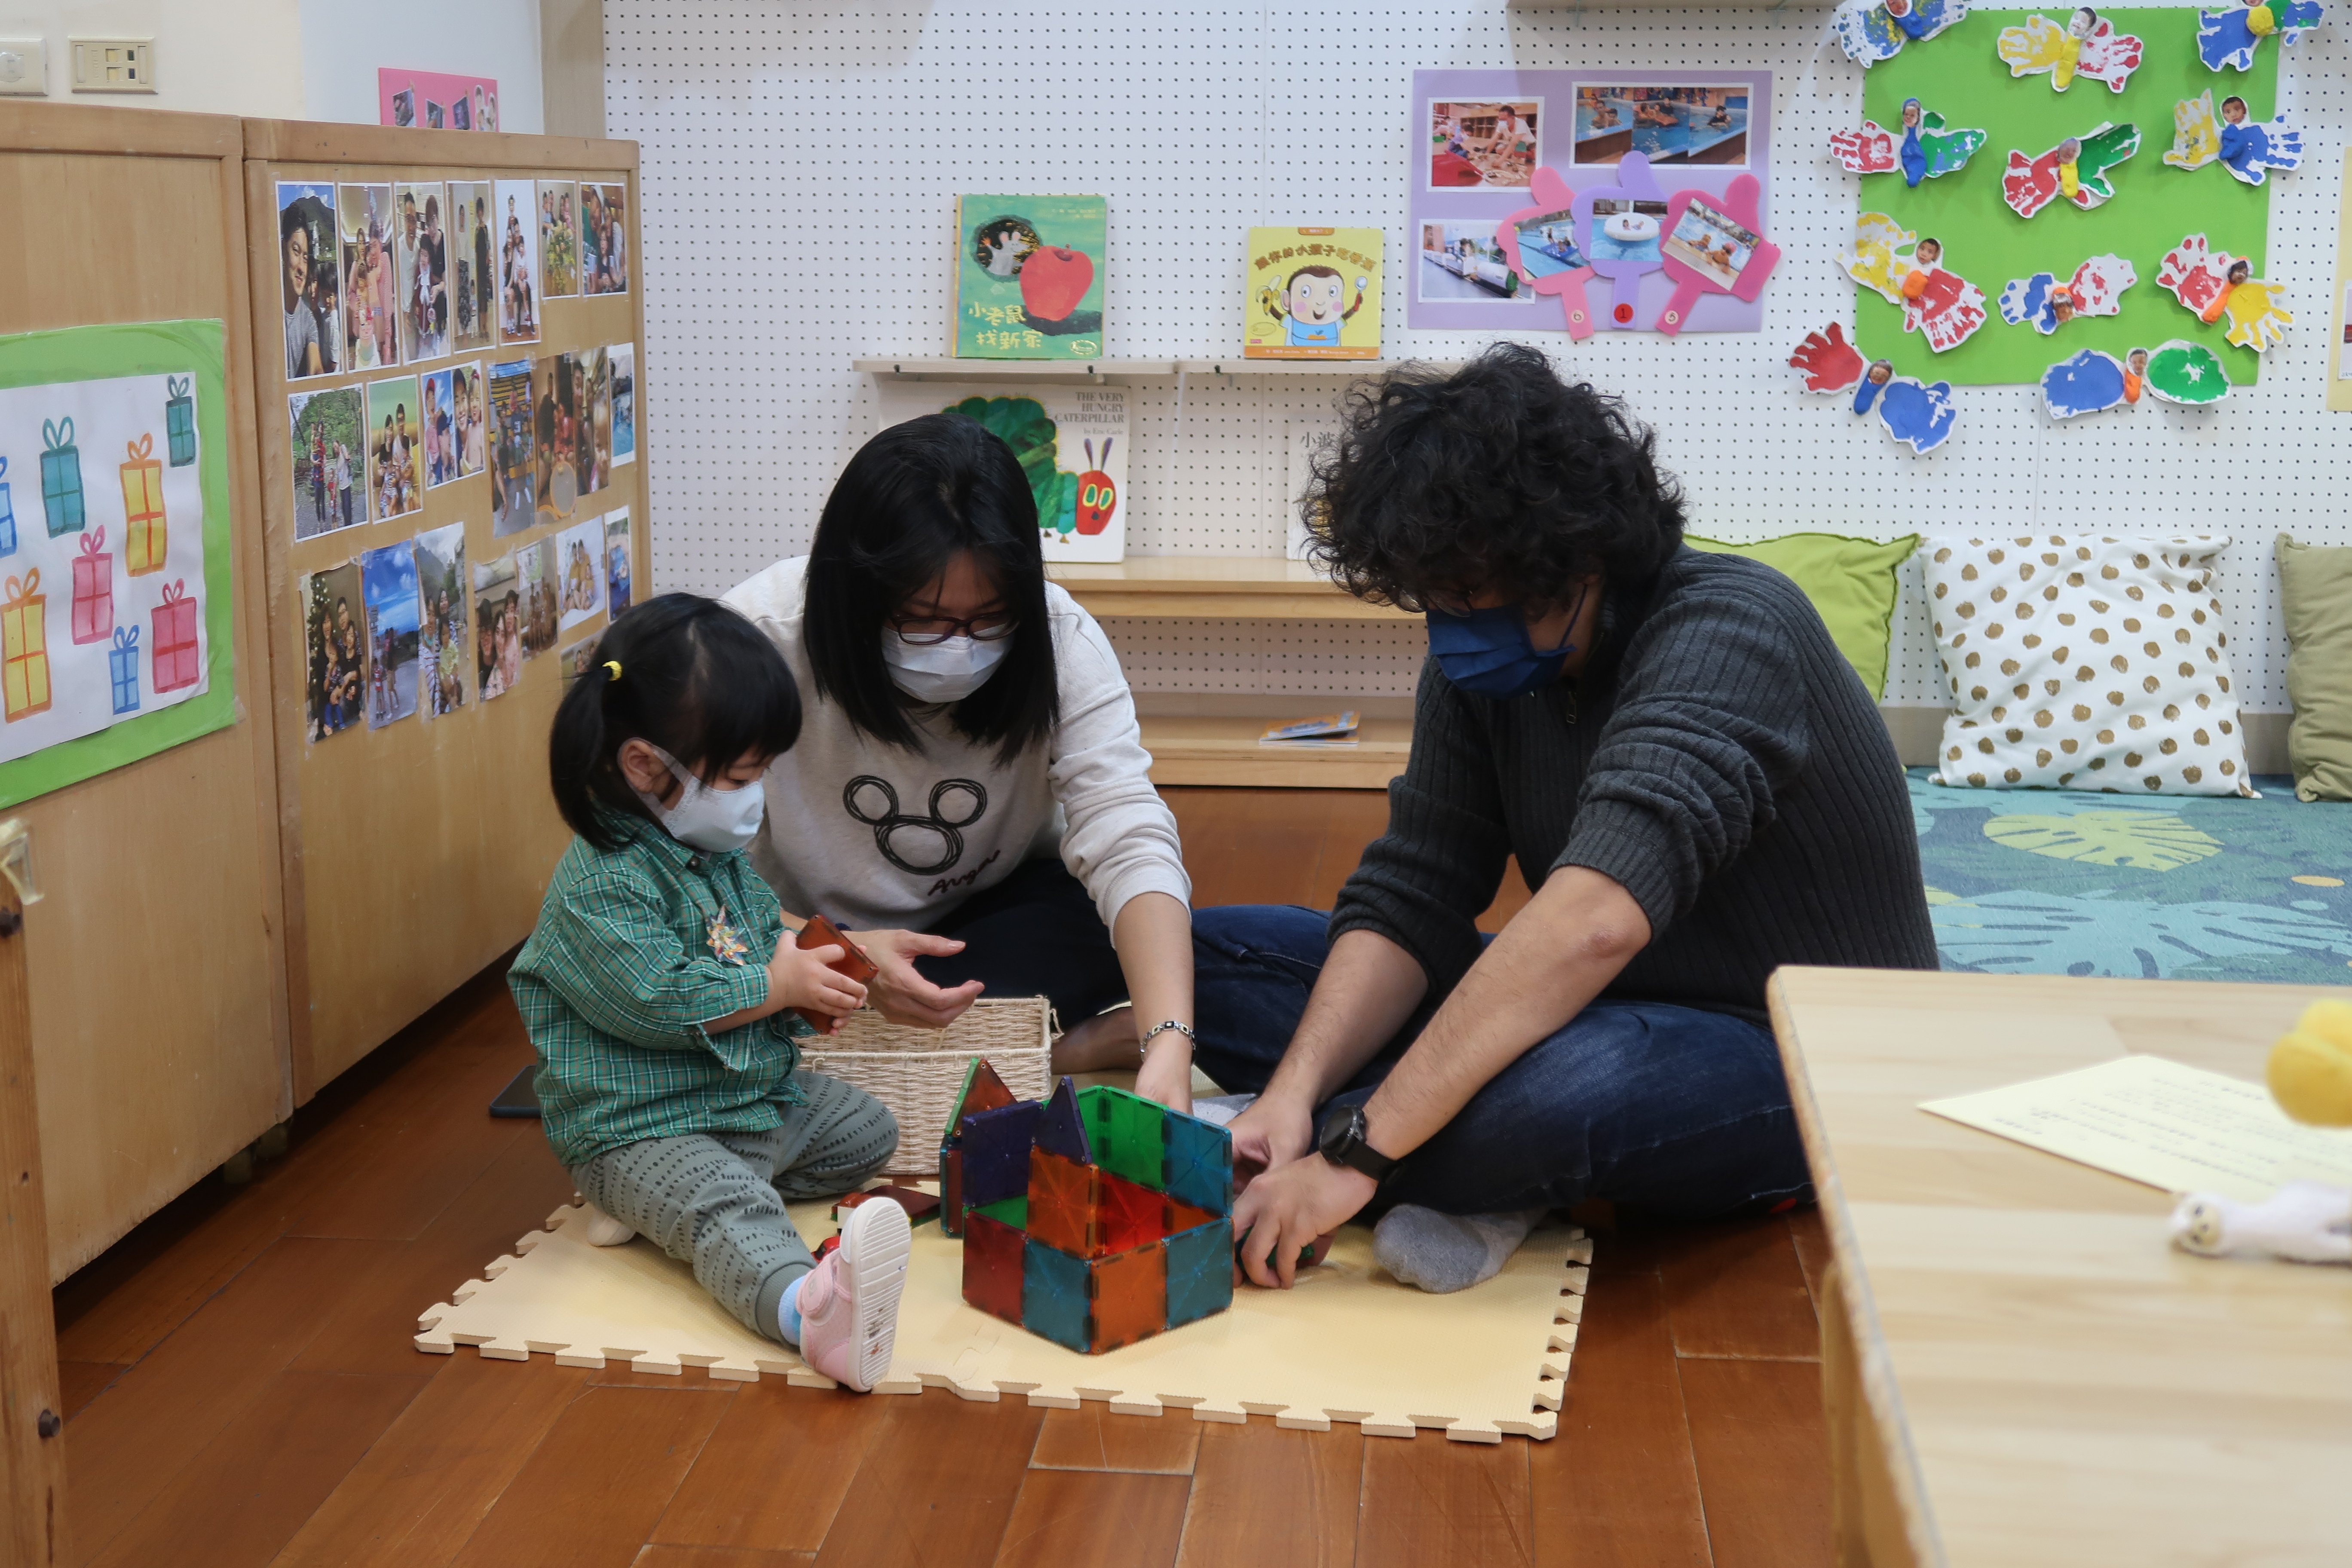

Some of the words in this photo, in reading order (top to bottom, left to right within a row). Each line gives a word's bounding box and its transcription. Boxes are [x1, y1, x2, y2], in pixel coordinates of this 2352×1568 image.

[968, 301, 1026, 326] 小老鼠
[1669, 312, 1676, 322] 5
[976, 329, 1043, 349] 找新家
[1075, 392, 1096, 401] THE
[1099, 392, 1124, 402] VERY
[1081, 403, 1123, 412] HUNGRY
[1055, 413, 1124, 423] CATERPILLAR
